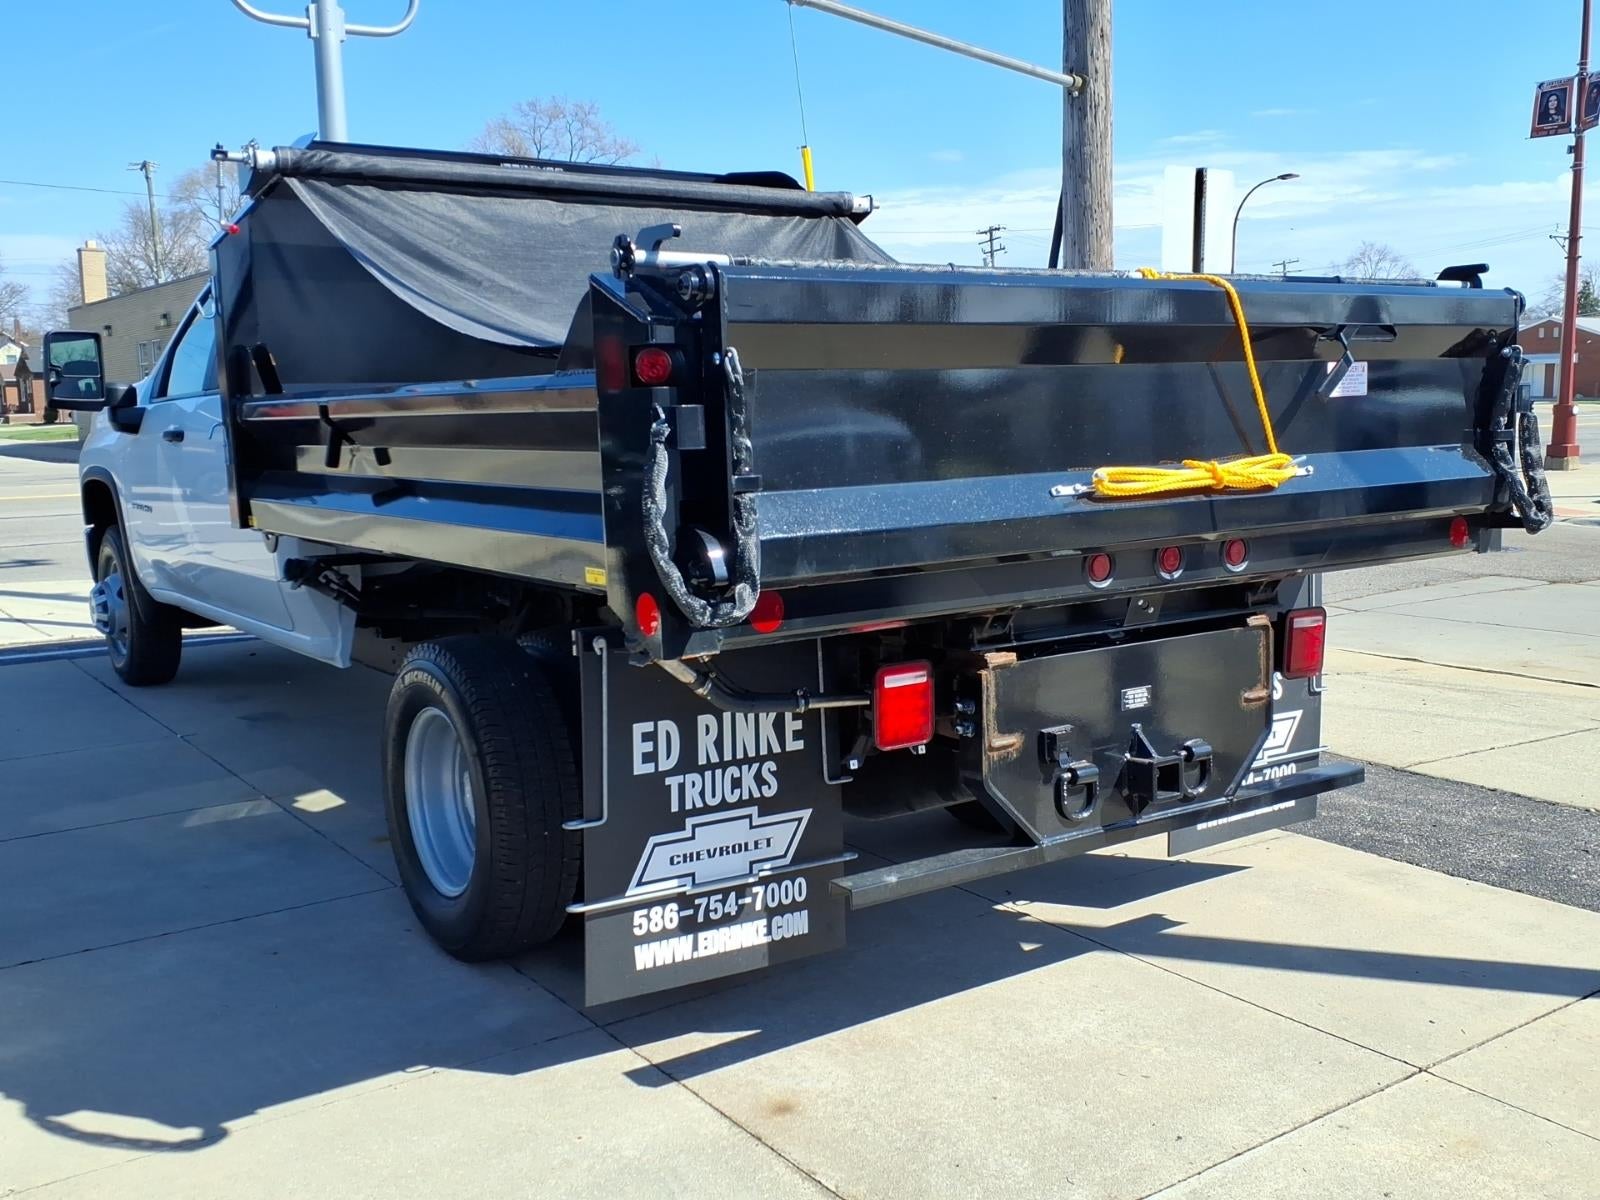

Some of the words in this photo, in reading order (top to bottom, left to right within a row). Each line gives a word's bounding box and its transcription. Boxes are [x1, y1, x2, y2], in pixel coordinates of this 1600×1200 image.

[404, 670, 442, 695] MICHELIN
[632, 720, 681, 775] ED
[697, 711, 804, 765] RINKE
[665, 761, 778, 812] TRUCKS
[669, 836, 774, 866] CHEVROLET
[632, 876, 808, 936] 586-754-7000
[634, 909, 809, 971] WWW.EDRINKE.COM
